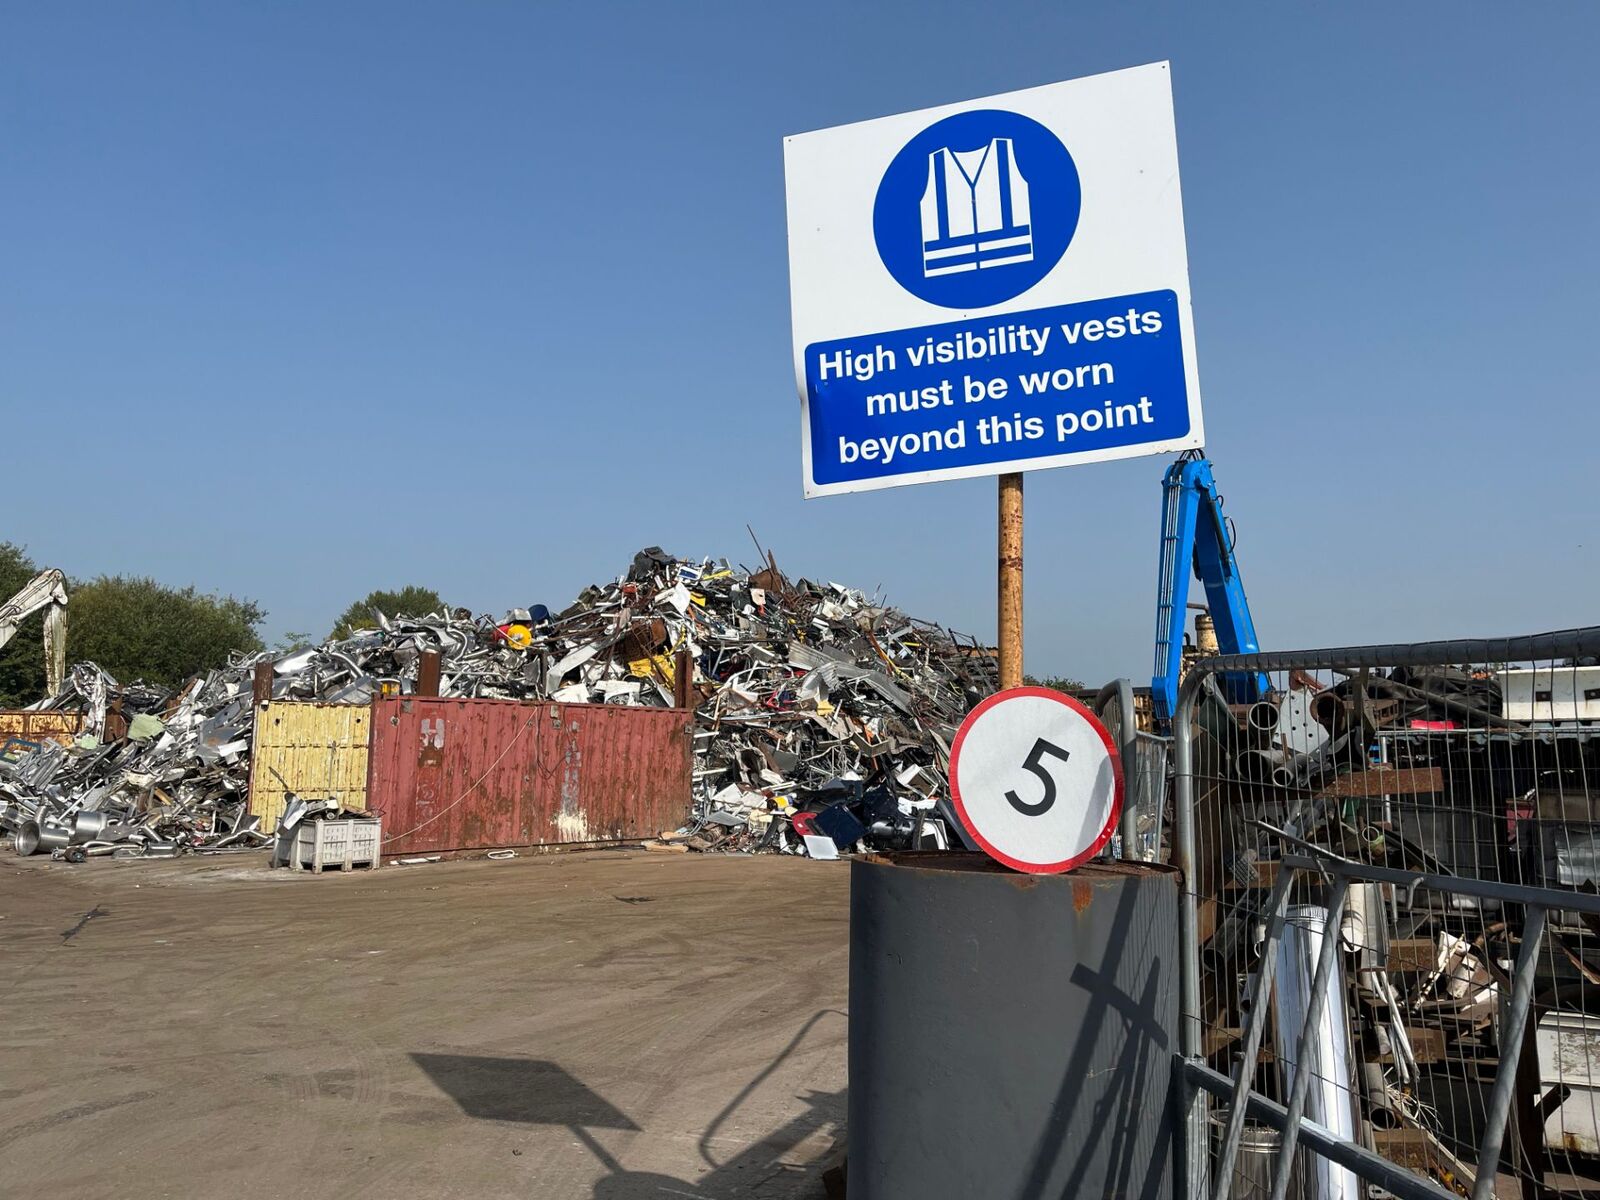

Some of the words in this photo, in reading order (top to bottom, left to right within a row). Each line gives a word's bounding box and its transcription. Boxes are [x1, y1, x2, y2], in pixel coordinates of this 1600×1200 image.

[819, 344, 896, 381] High
[906, 325, 1051, 367] visibility
[1060, 308, 1163, 345] vests
[866, 379, 954, 417] must
[963, 375, 1008, 403] be
[1018, 362, 1115, 395] worn
[838, 419, 966, 464] beyond
[976, 412, 1045, 445] this
[1056, 396, 1154, 442] point
[1004, 737, 1070, 817] 5
